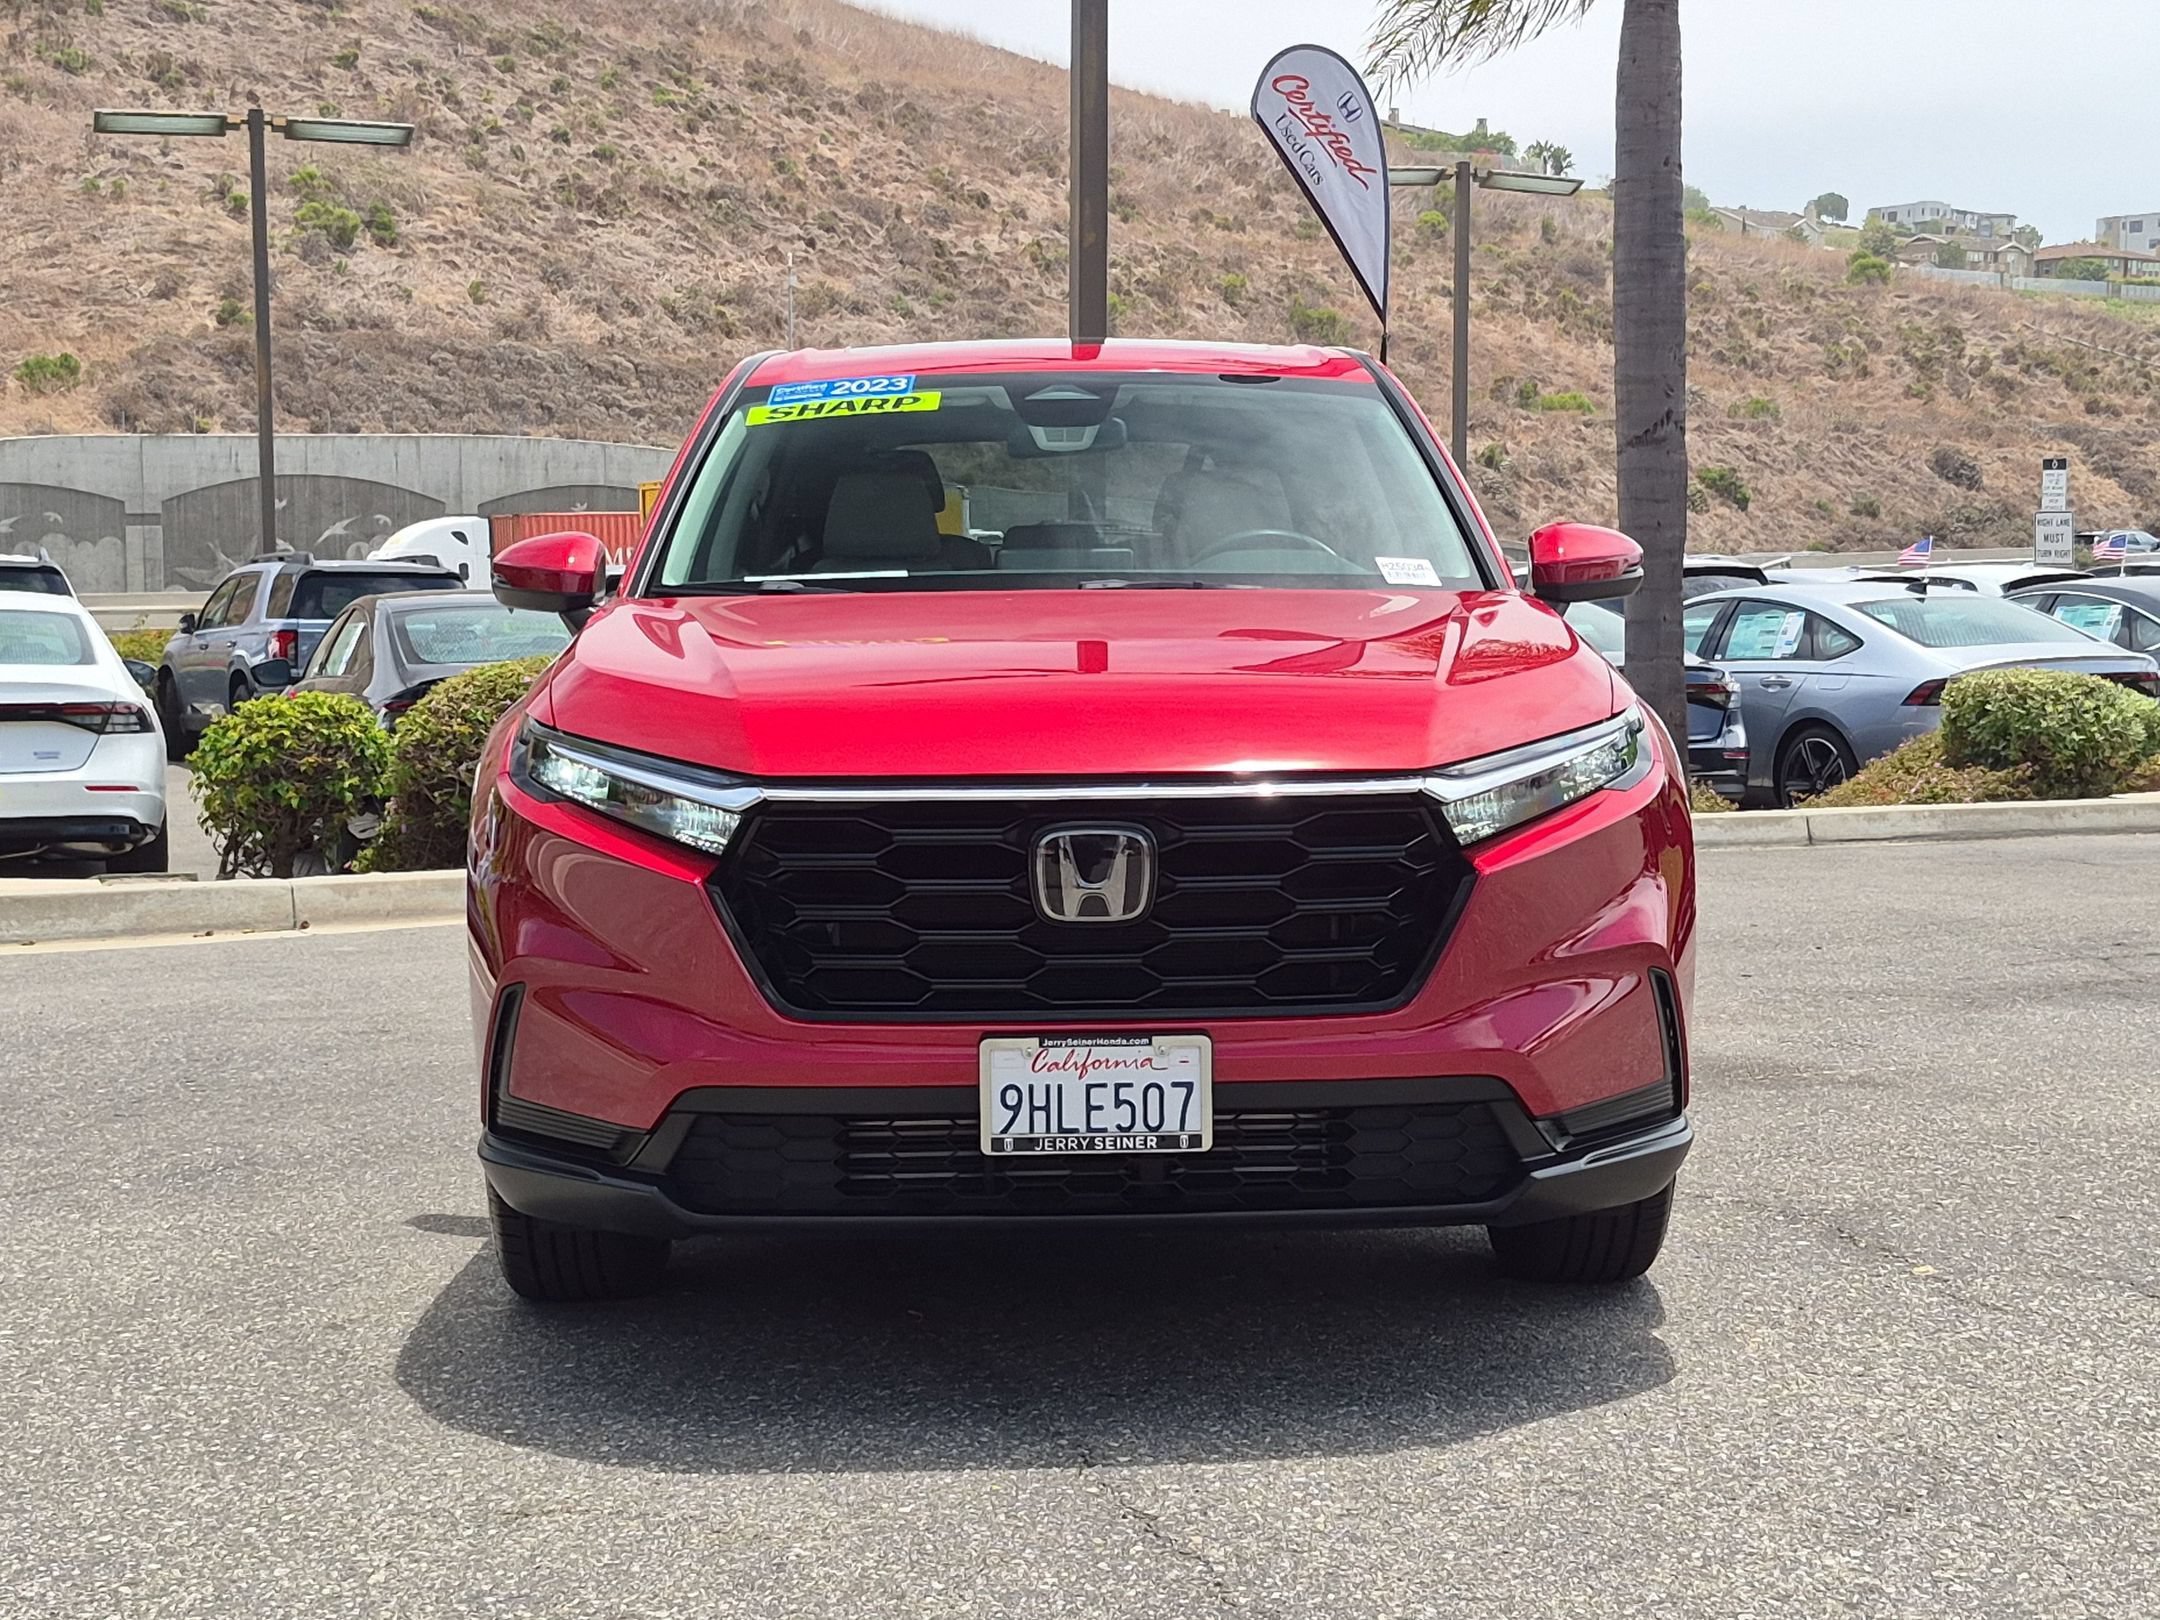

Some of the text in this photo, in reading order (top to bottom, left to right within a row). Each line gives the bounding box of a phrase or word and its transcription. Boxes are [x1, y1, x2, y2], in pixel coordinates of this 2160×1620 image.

[1271, 74, 1377, 191] Certified
[1274, 112, 1324, 186] Used Cars
[830, 378, 908, 395] 2023
[765, 396, 921, 420] SHARP
[2043, 533, 2064, 544] MUST
[1041, 1037, 1149, 1048] JerrySeinerHonda.com
[1031, 1048, 1168, 1080] California
[999, 1081, 1195, 1134] 9HLE507
[1034, 1136, 1158, 1151] JERRY SEINER
